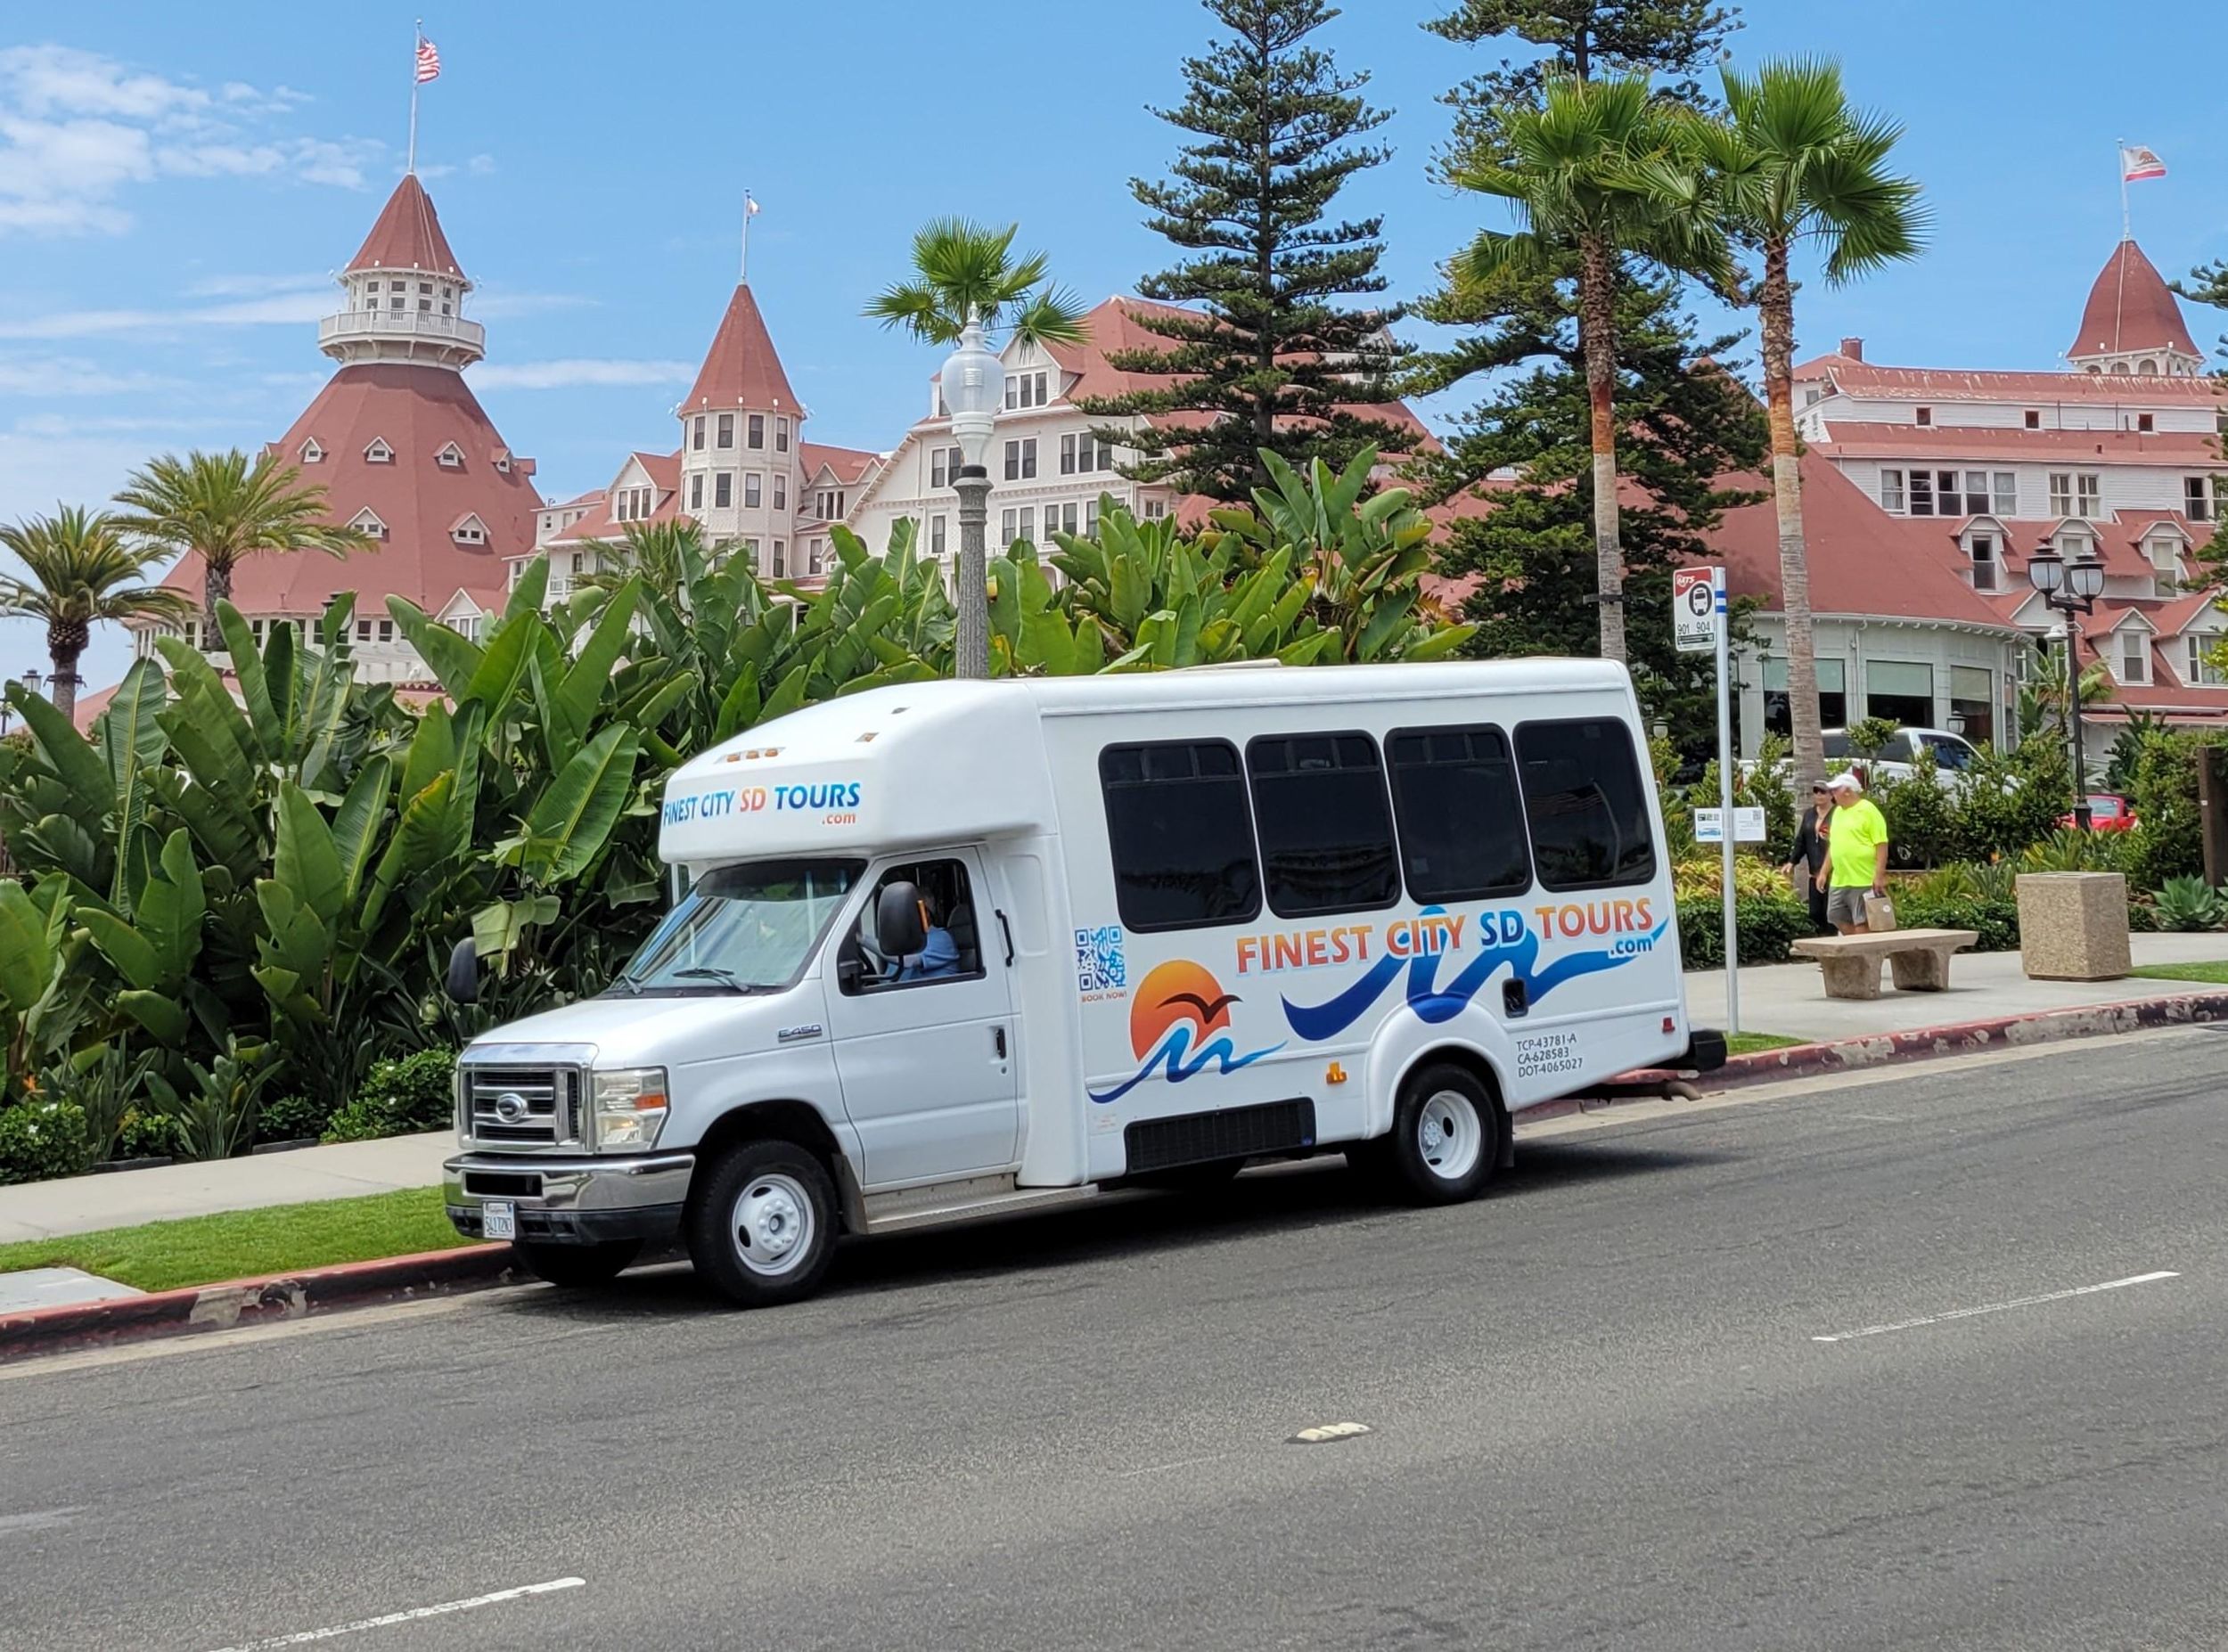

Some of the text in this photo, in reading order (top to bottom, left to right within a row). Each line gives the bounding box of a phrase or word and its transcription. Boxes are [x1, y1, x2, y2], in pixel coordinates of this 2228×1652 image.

[1676, 621, 1710, 634] 901 904
[663, 782, 861, 826] FINEST CITY SD TOURS
[821, 812, 856, 824] .com
[1236, 898, 1654, 974] FINEST CITY SD TOURS
[1609, 935, 1653, 956] .com
[1082, 993, 1104, 1002] BOOK
[1516, 1033, 1577, 1052] TCP-43781-A
[1517, 1046, 1569, 1065] CA-628583
[1518, 1057, 1584, 1078] DOT-4065027
